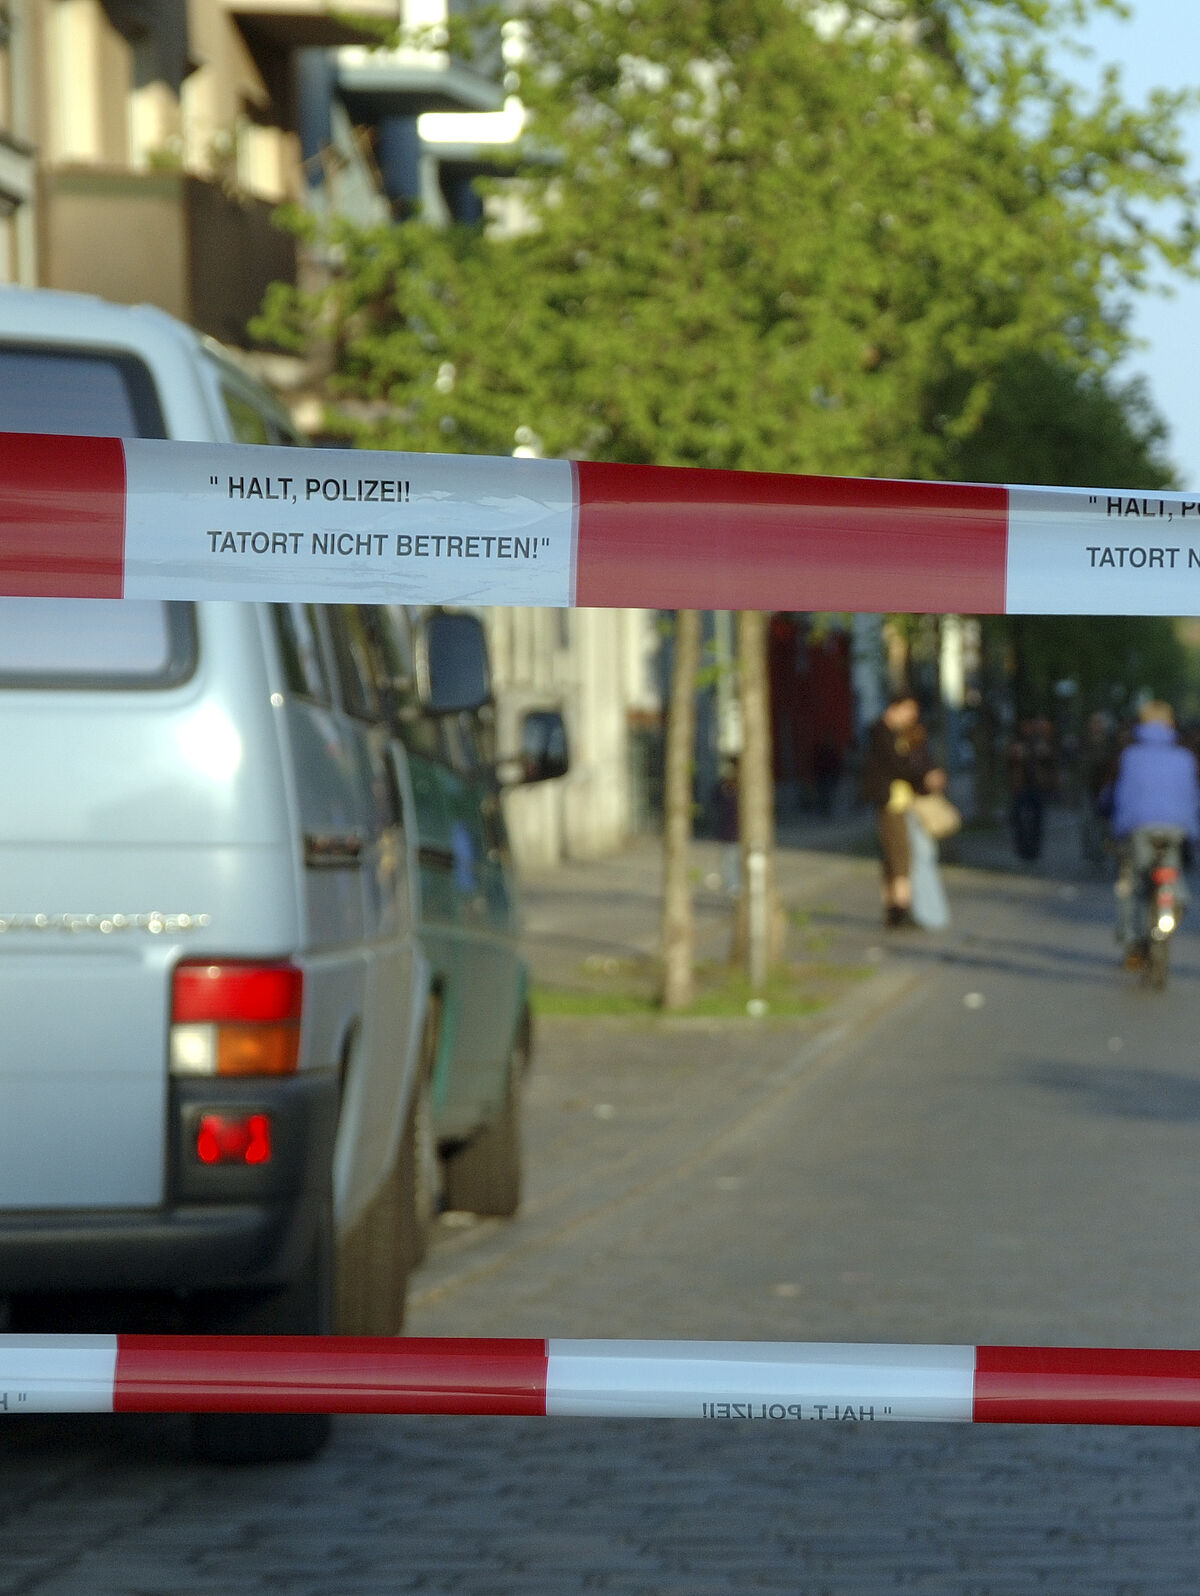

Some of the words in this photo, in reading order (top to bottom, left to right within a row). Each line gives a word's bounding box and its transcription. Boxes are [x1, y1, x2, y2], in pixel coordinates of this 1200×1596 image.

[228, 476, 298, 504] HALT,
[305, 477, 411, 503] POLIZEI!
[207, 531, 303, 555] TATORT
[311, 532, 389, 557] NICHT
[398, 535, 550, 560] BETRETEN!"
[1085, 547, 1181, 569] TATORT
